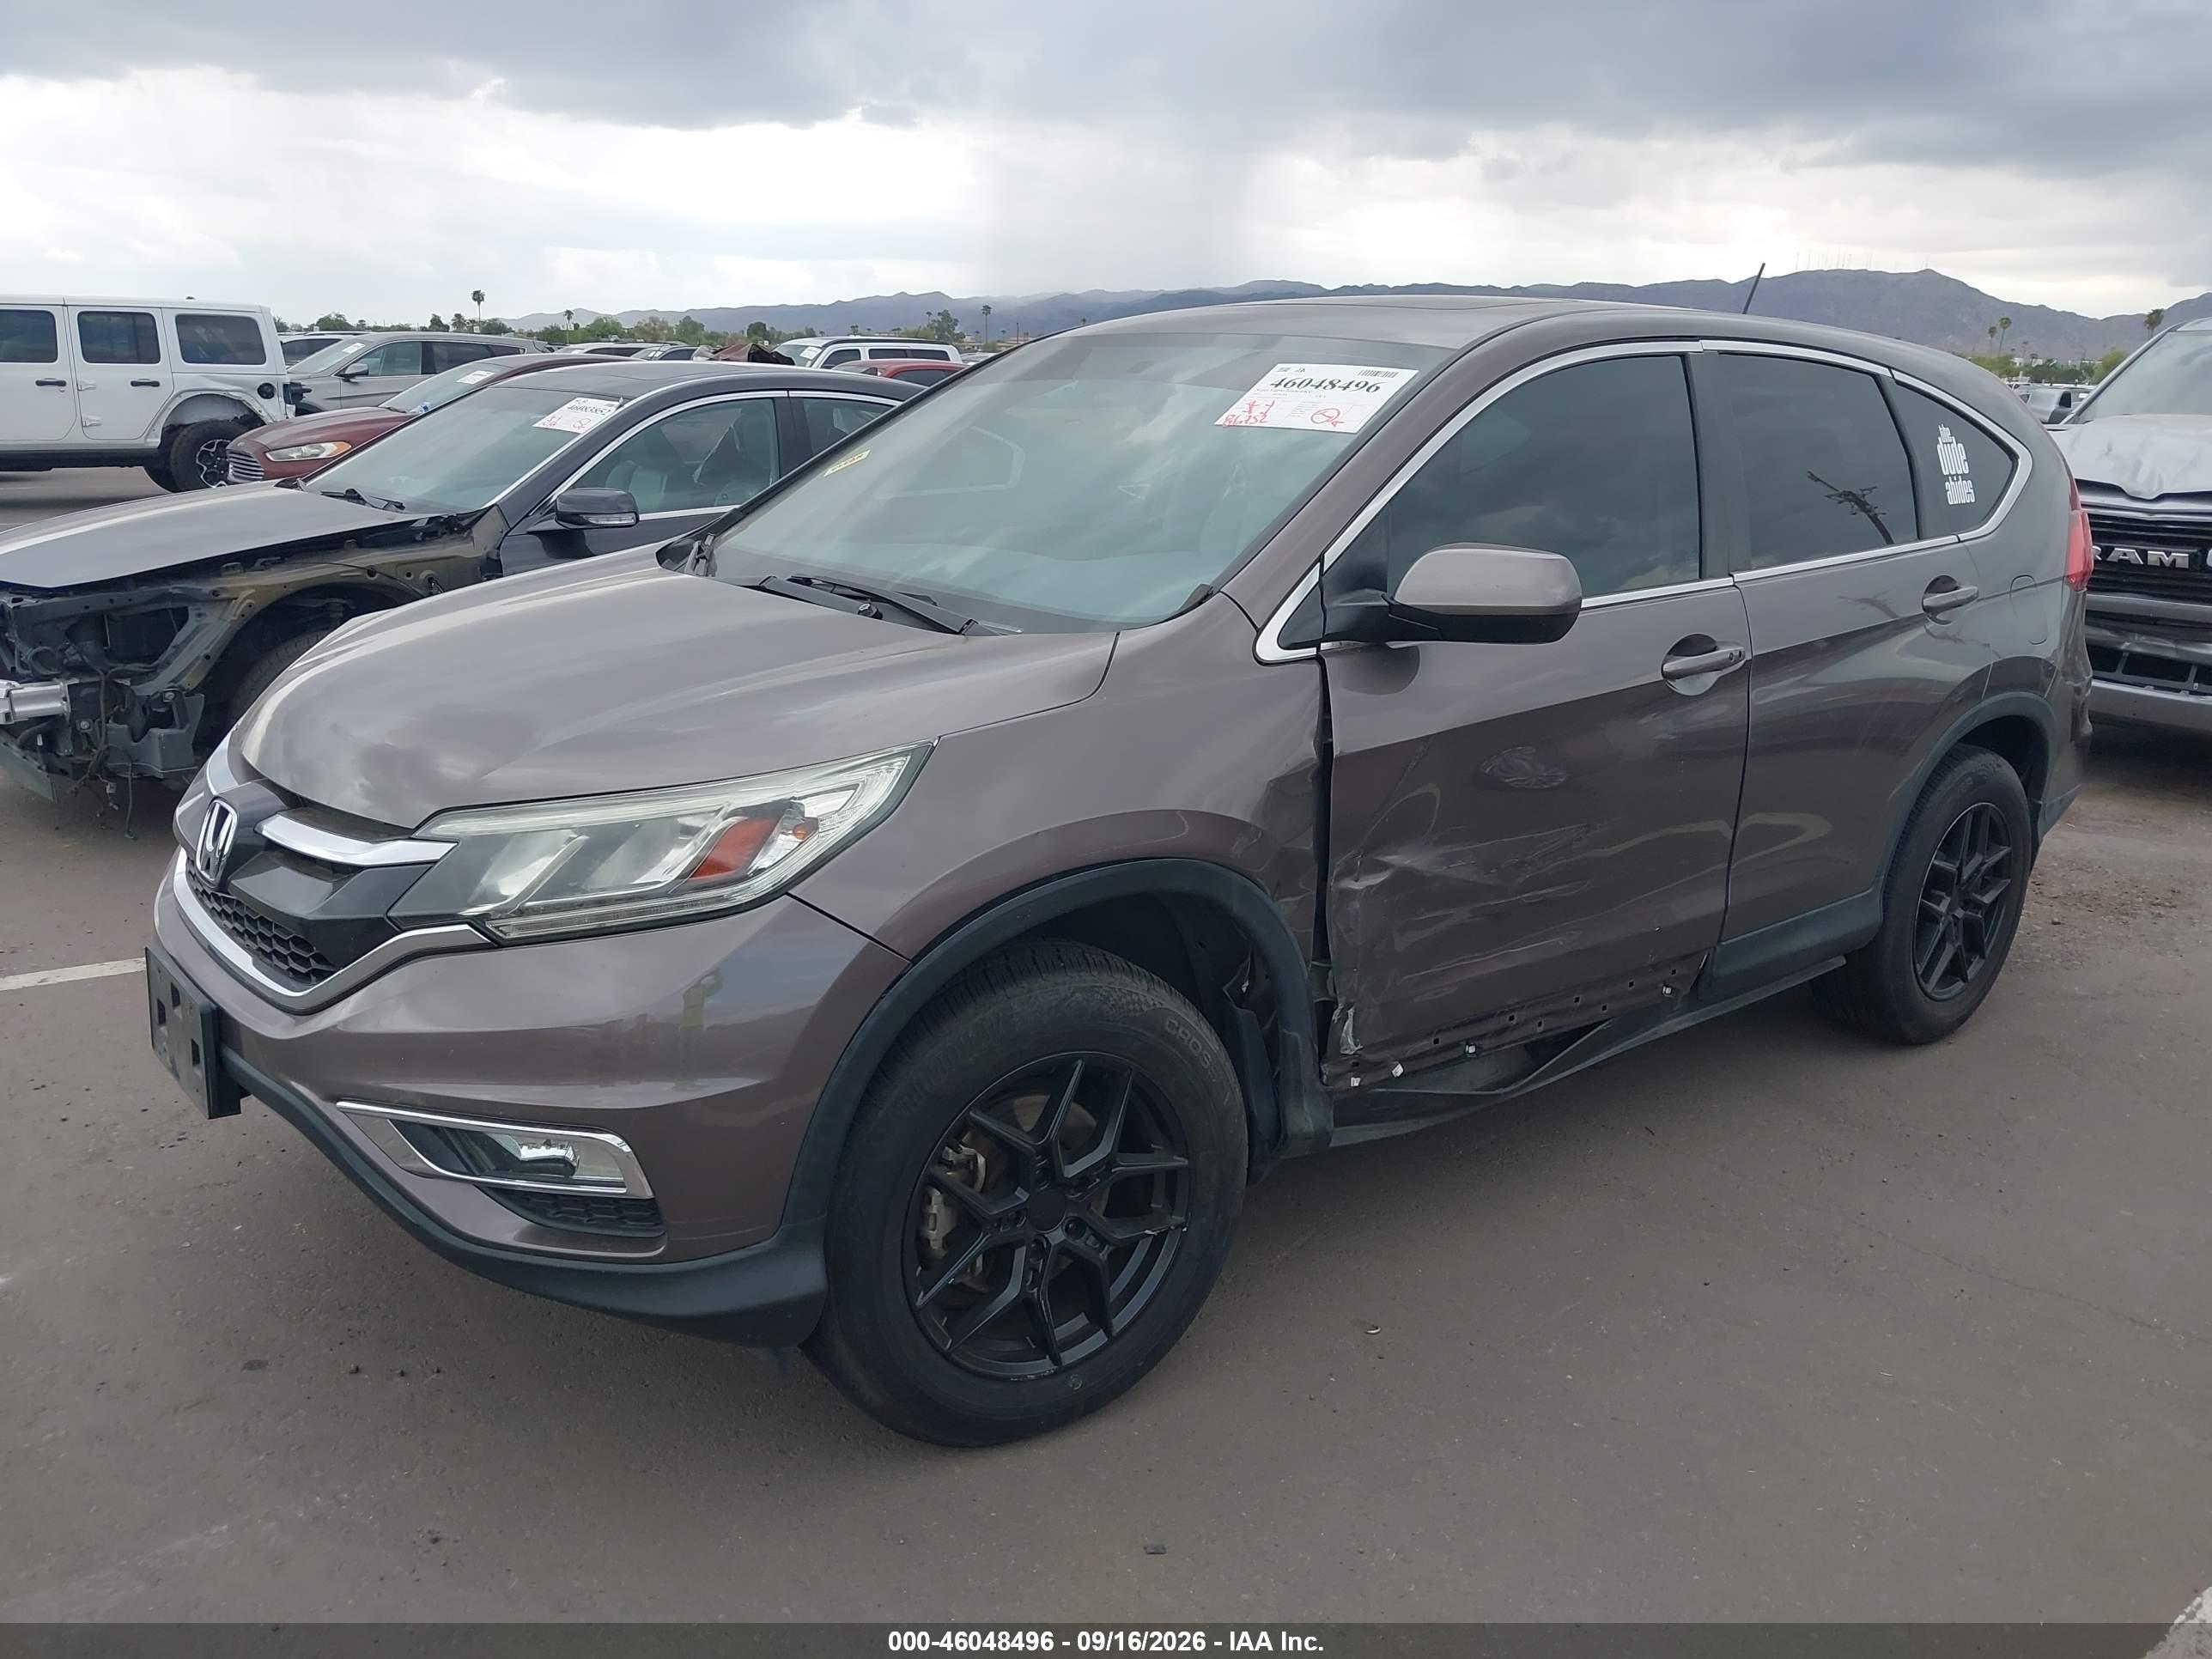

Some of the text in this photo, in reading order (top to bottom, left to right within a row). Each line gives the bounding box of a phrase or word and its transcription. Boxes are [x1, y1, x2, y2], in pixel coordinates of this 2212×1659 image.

[1270, 377, 1382, 393] 46048496
[1936, 436, 1970, 476] dude
[1945, 476, 1976, 505] abides
